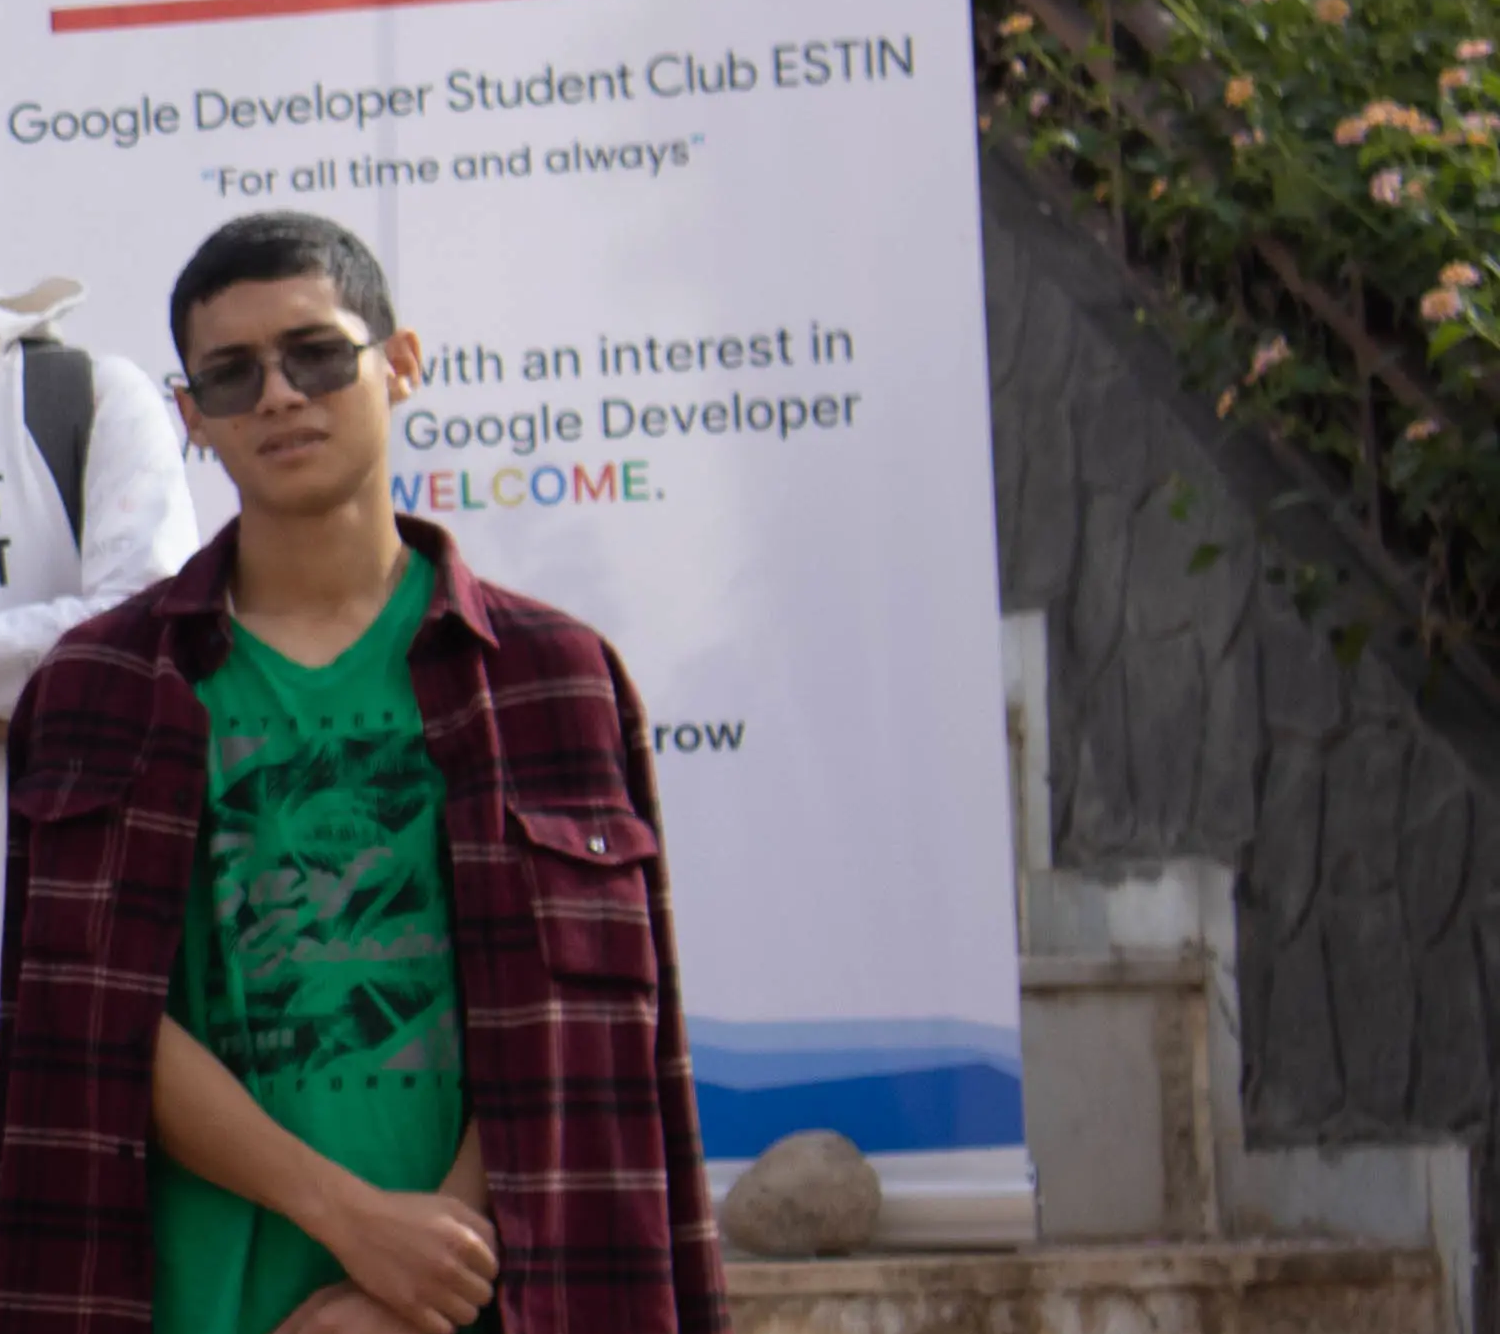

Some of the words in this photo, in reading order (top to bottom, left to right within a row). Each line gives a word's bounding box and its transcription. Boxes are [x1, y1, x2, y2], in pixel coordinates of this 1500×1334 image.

[7, 96, 180, 149] Google
[194, 83, 430, 131] Developer
[447, 64, 631, 112] Student
[646, 51, 758, 97] Club
[772, 36, 914, 87] ESTIN
[290, 160, 336, 192] all
[349, 158, 439, 187] time
[452, 146, 532, 180] and
[522, 348, 581, 380] an
[600, 328, 793, 374] interest
[811, 320, 854, 366] in
[403, 409, 583, 457] Google
[600, 391, 861, 442] Developer
[653, 722, 744, 753] row
